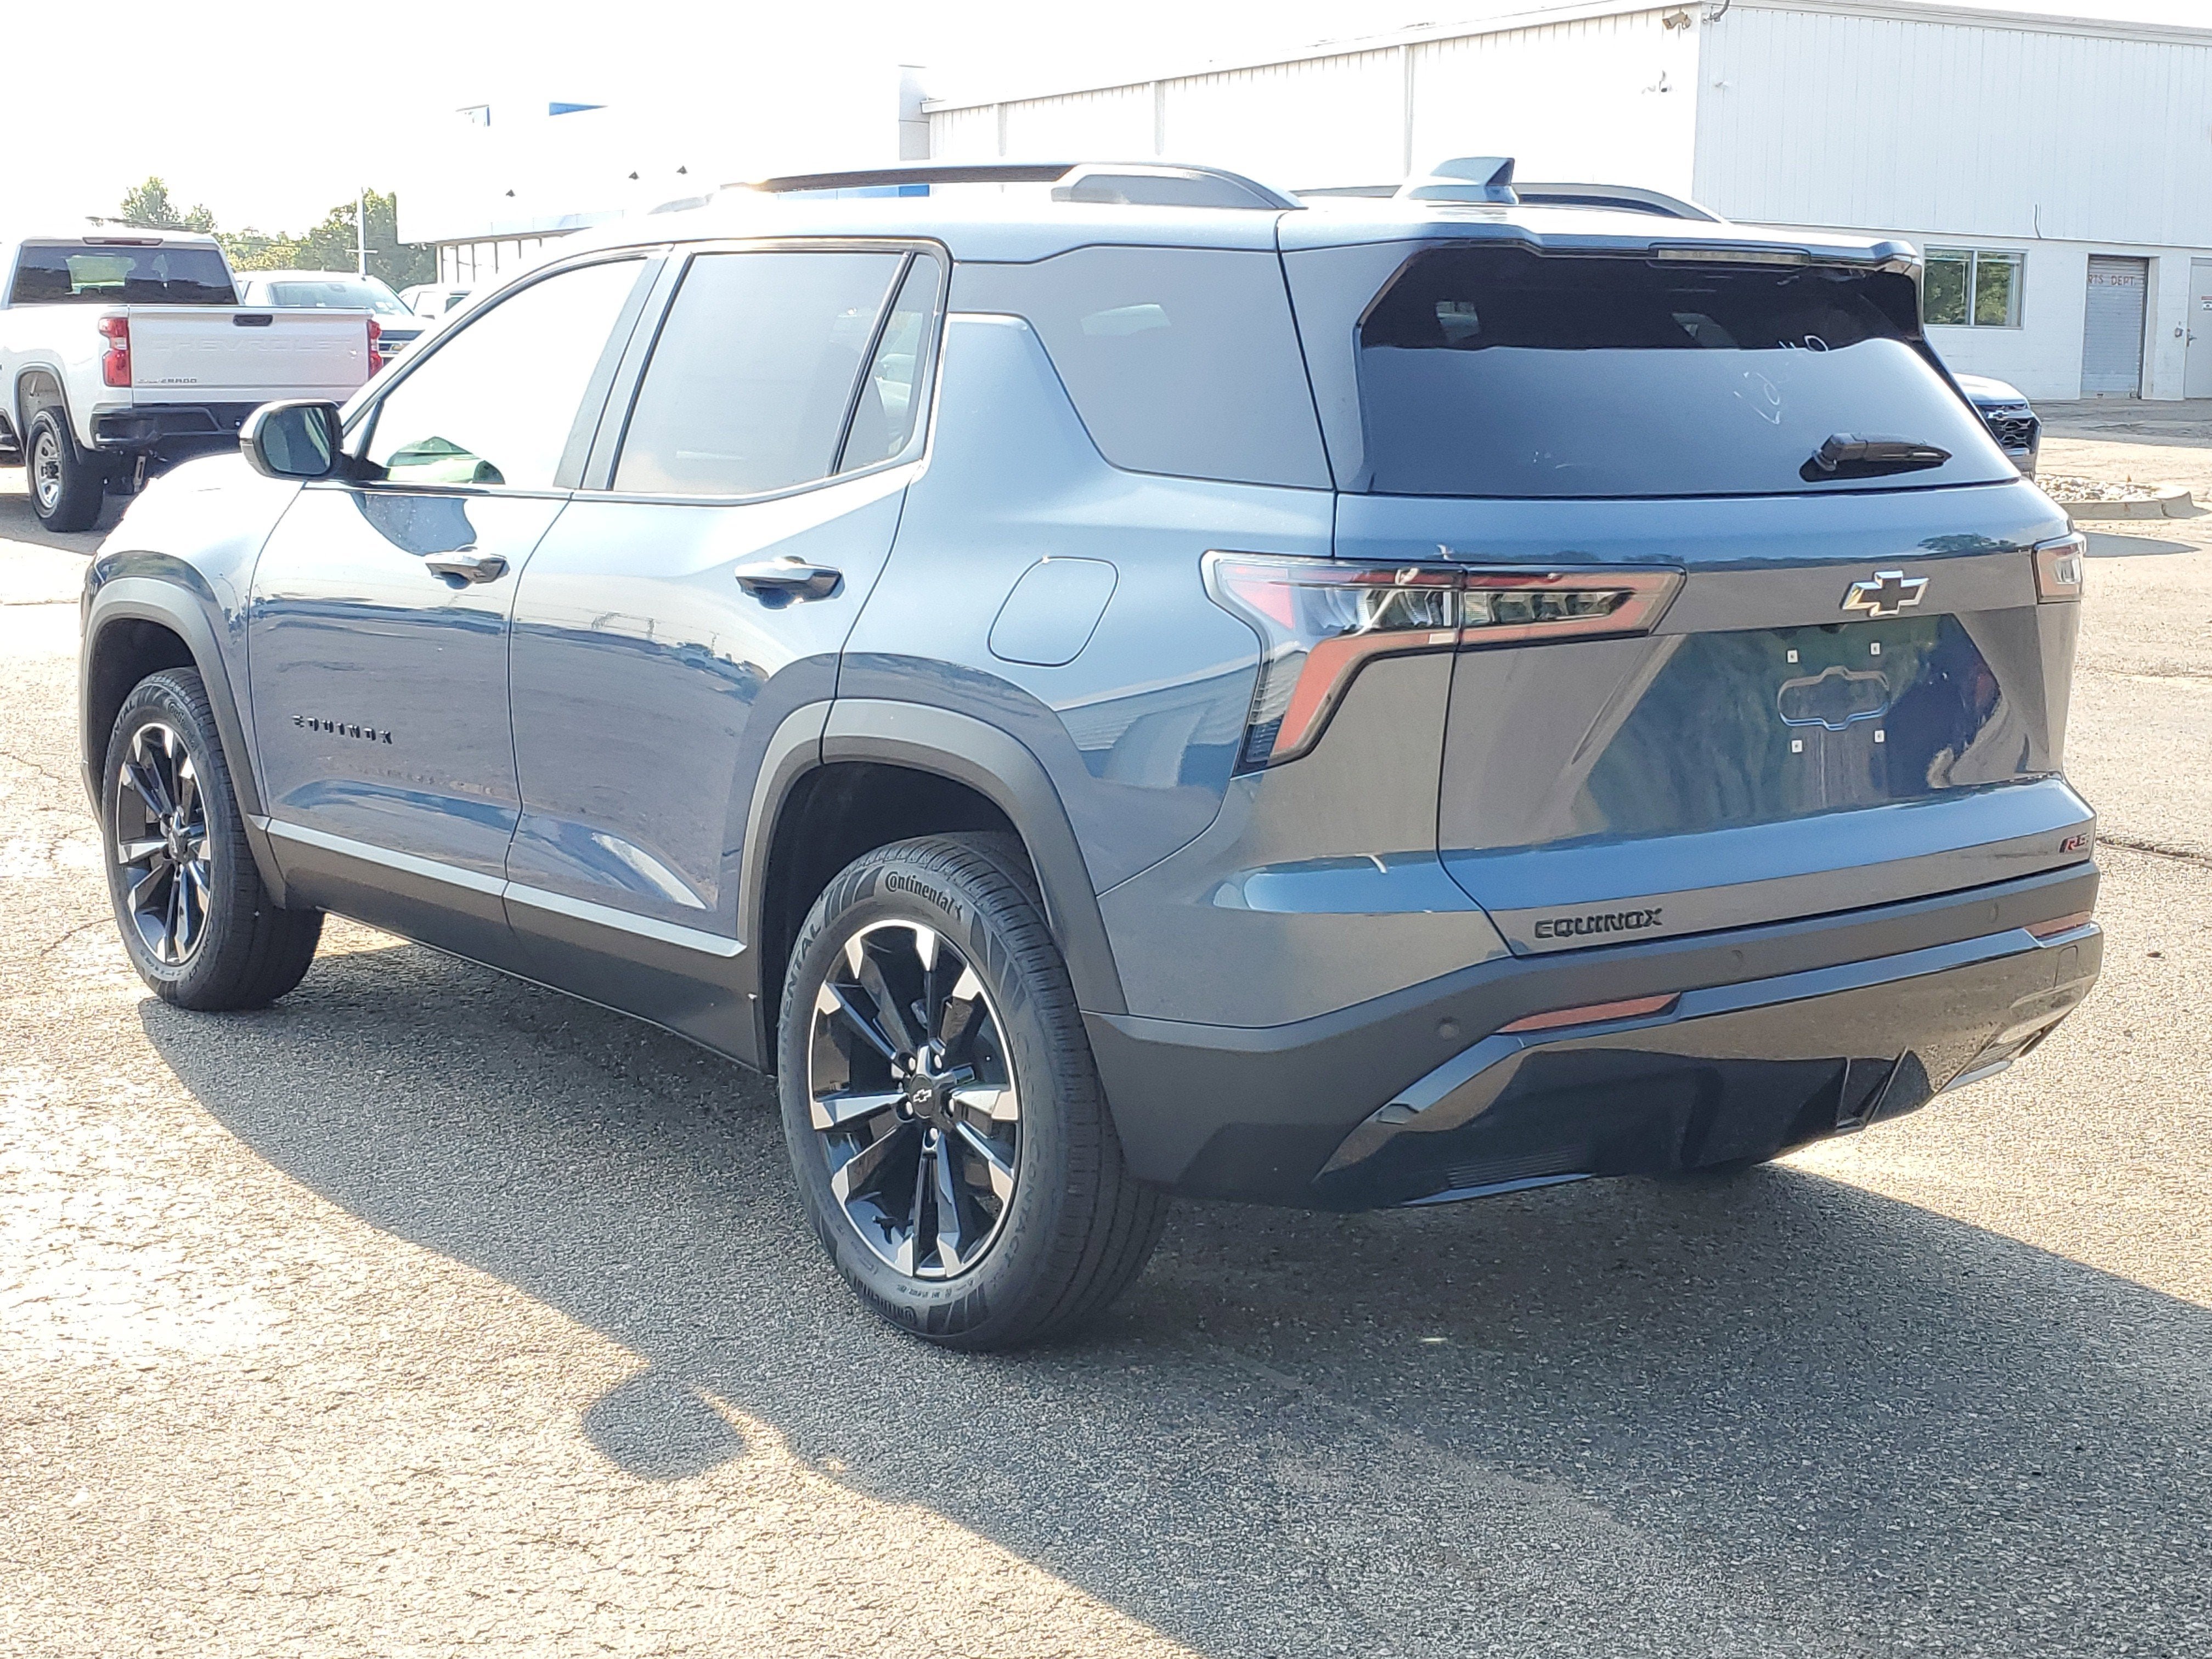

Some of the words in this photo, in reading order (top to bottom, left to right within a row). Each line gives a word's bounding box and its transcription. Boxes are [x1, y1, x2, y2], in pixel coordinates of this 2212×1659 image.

[291, 714, 393, 744] EQUINOX
[885, 871, 955, 916] Continental
[1534, 908, 1663, 939] EQUINOX
